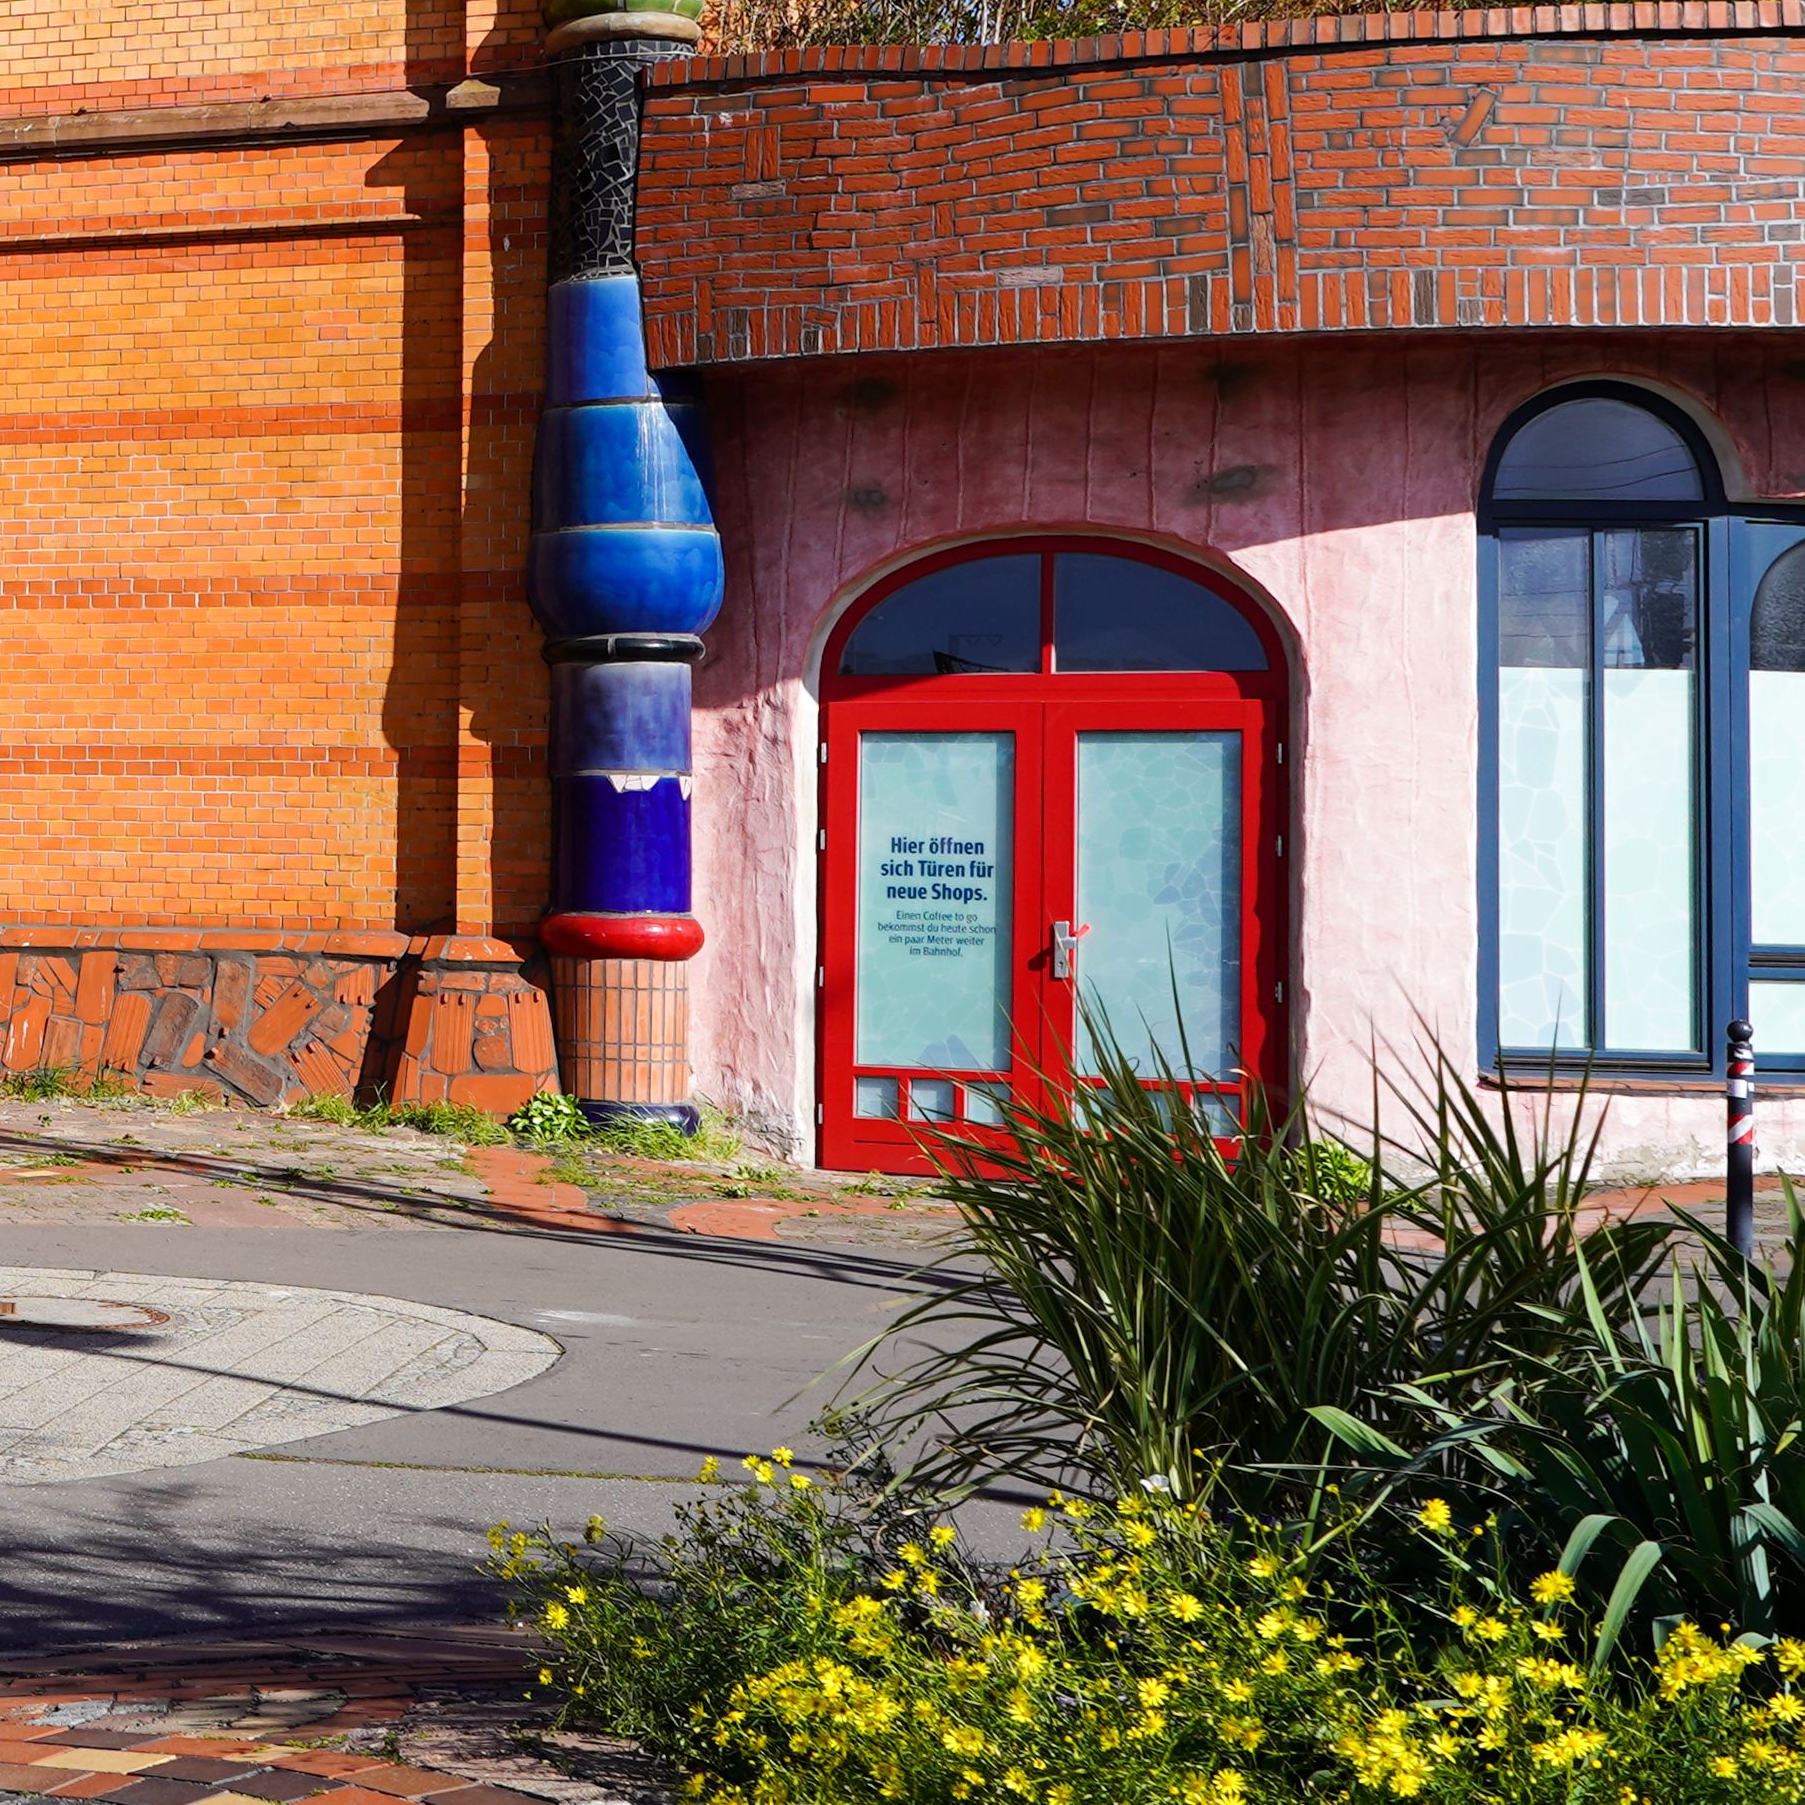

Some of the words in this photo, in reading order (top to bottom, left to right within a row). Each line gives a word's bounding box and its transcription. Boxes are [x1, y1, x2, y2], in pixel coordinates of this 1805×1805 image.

[891, 837, 925, 854] Hier
[929, 837, 985, 855] öffnen
[880, 859, 914, 876] sich
[918, 860, 965, 877] Türen
[969, 860, 994, 878] für
[887, 885, 927, 900] neue
[931, 883, 988, 905] Shops.
[896, 910, 921, 920] Einen
[923, 911, 953, 922] Coffee
[955, 912, 965, 922] to
[966, 913, 978, 924] go
[877, 922, 925, 932] bekommst
[927, 923, 939, 933] du
[940, 924, 967, 934] heute
[969, 925, 997, 935] schon
[889, 935, 903, 944] ein
[904, 936, 924, 946] paar
[927, 935, 953, 945] Meter
[956, 936, 985, 946] weiter
[909, 946, 921, 955] im
[923, 946, 964, 957] Bahnhof.
